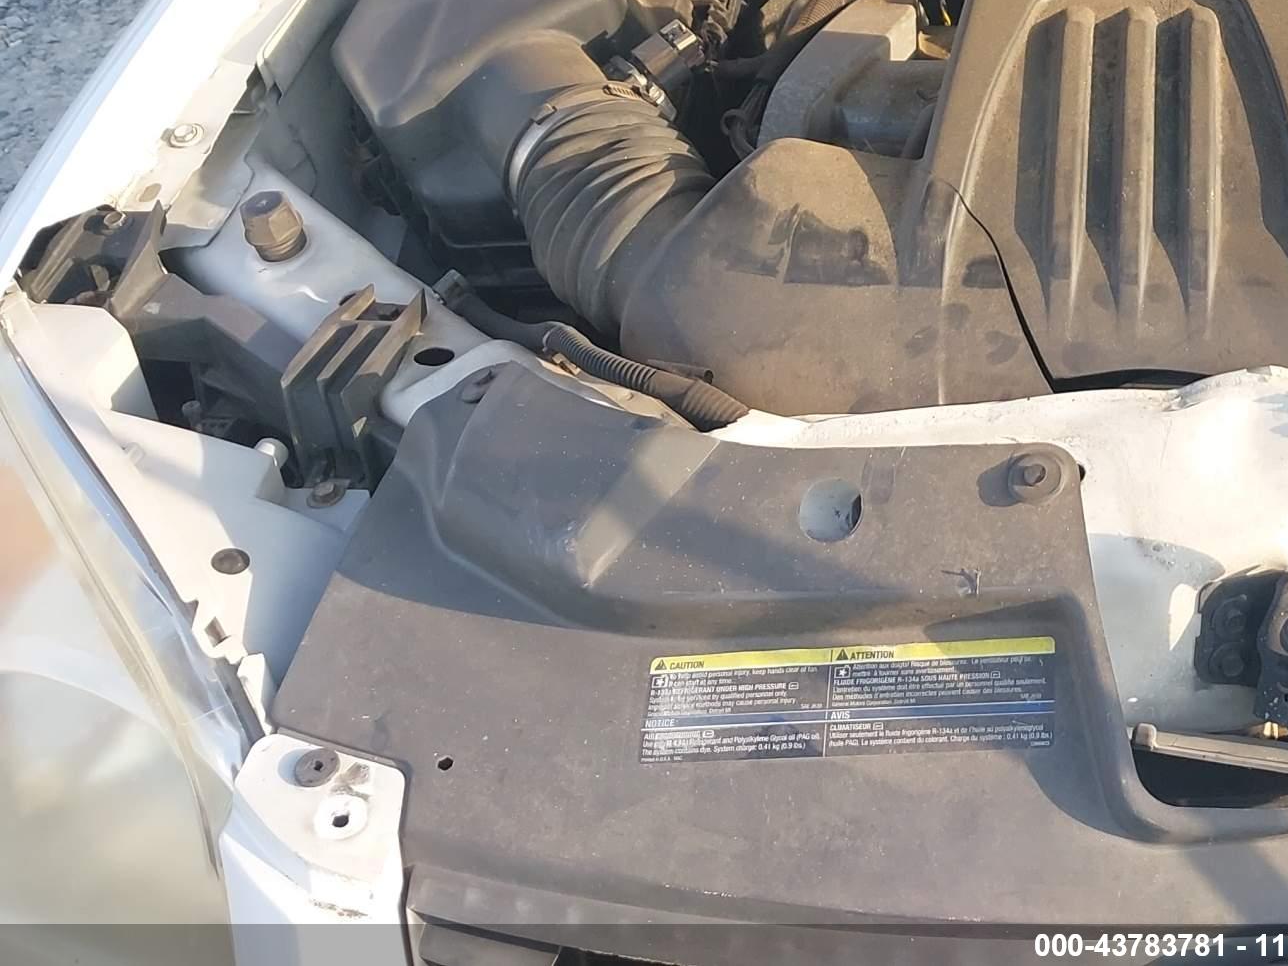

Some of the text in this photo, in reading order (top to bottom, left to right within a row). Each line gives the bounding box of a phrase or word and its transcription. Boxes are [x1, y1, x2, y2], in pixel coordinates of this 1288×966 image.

[850, 650, 894, 660] ATTENTION
[669, 661, 704, 670] CAUTION
[910, 660, 929, 668] Risque
[708, 670, 732, 678] personal
[959, 671, 989, 680] PRESSION
[754, 682, 786, 690] PRESSURE
[871, 684, 895, 693] système
[965, 680, 992, 688] personnel
[719, 692, 744, 701] qualified
[745, 691, 774, 699] personnel
[937, 689, 960, 697] peuvent
[753, 698, 779, 706] personal
[830, 711, 850, 719] AVIS
[645, 718, 675, 728] NOTICE
[829, 722, 871, 731] CLIMATISEUR
[796, 733, 810, 741] (PAG
[849, 730, 877, 738] seulement
[869, 737, 892, 746] système
[893, 736, 915, 744] contient
[950, 734, 969, 742] Charge
[979, 732, 1001, 741] système
[1028, 731, 1039, 739] (0.9
[713, 744, 734, 753] System
[780, 741, 792, 750] (0.9
